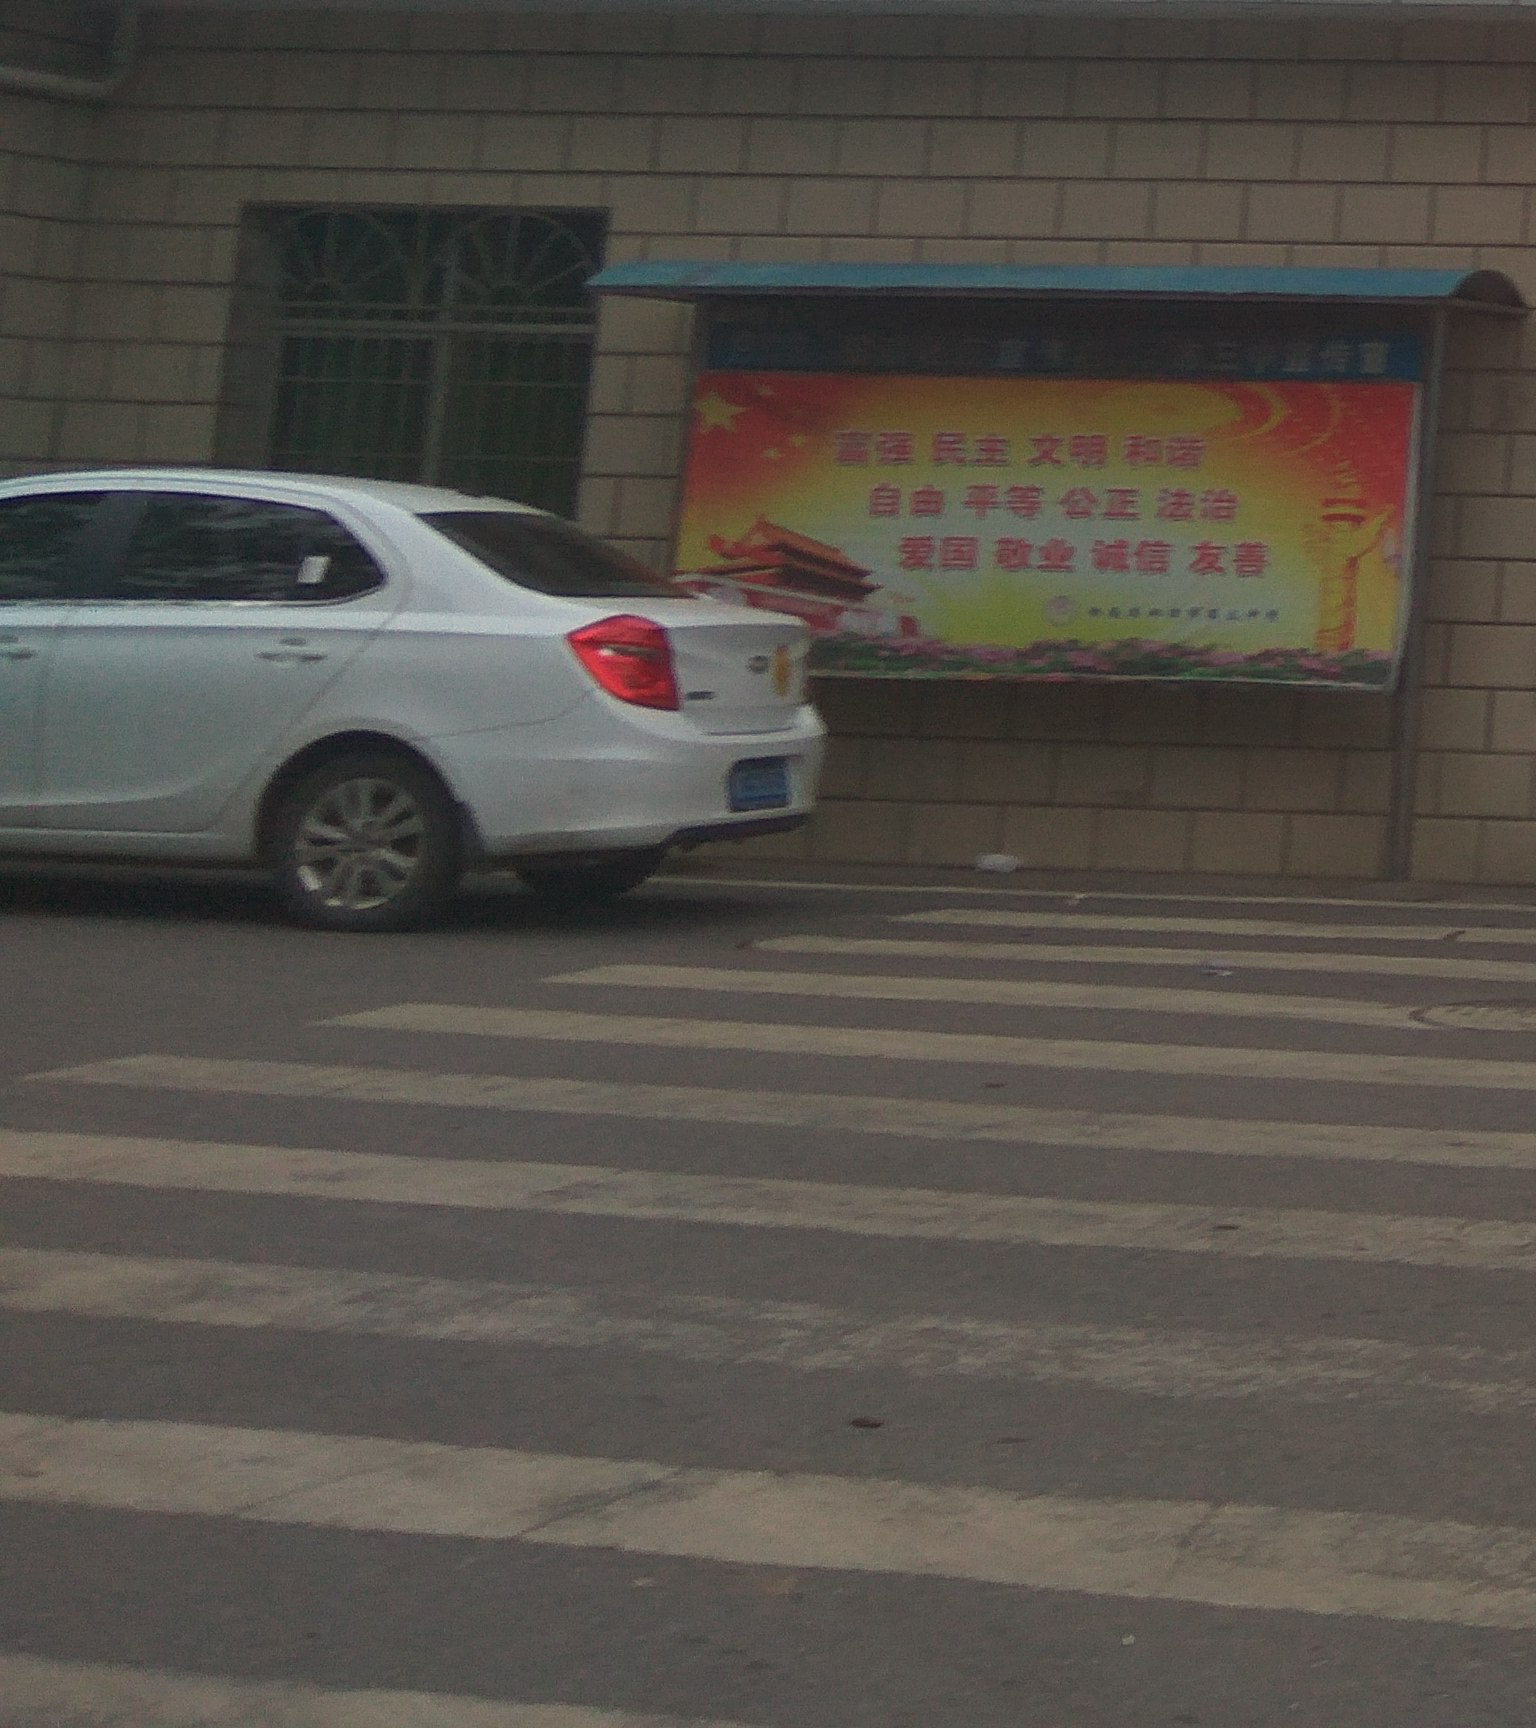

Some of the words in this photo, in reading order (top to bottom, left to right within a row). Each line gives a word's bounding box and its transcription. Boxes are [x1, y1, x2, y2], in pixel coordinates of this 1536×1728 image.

[835, 430, 914, 466] 富强
[931, 432, 1010, 466] 民主
[1026, 434, 1108, 469] 文明
[1123, 434, 1206, 470] 和谐
[868, 483, 946, 517] 自由
[963, 484, 1045, 519] 平等
[1059, 486, 1142, 521] 公正
[1155, 488, 1239, 523] 法治
[897, 535, 978, 571] 爱国
[994, 536, 1077, 573] 敬业
[1090, 538, 1174, 574] 诚信
[1187, 540, 1270, 578] 友善
